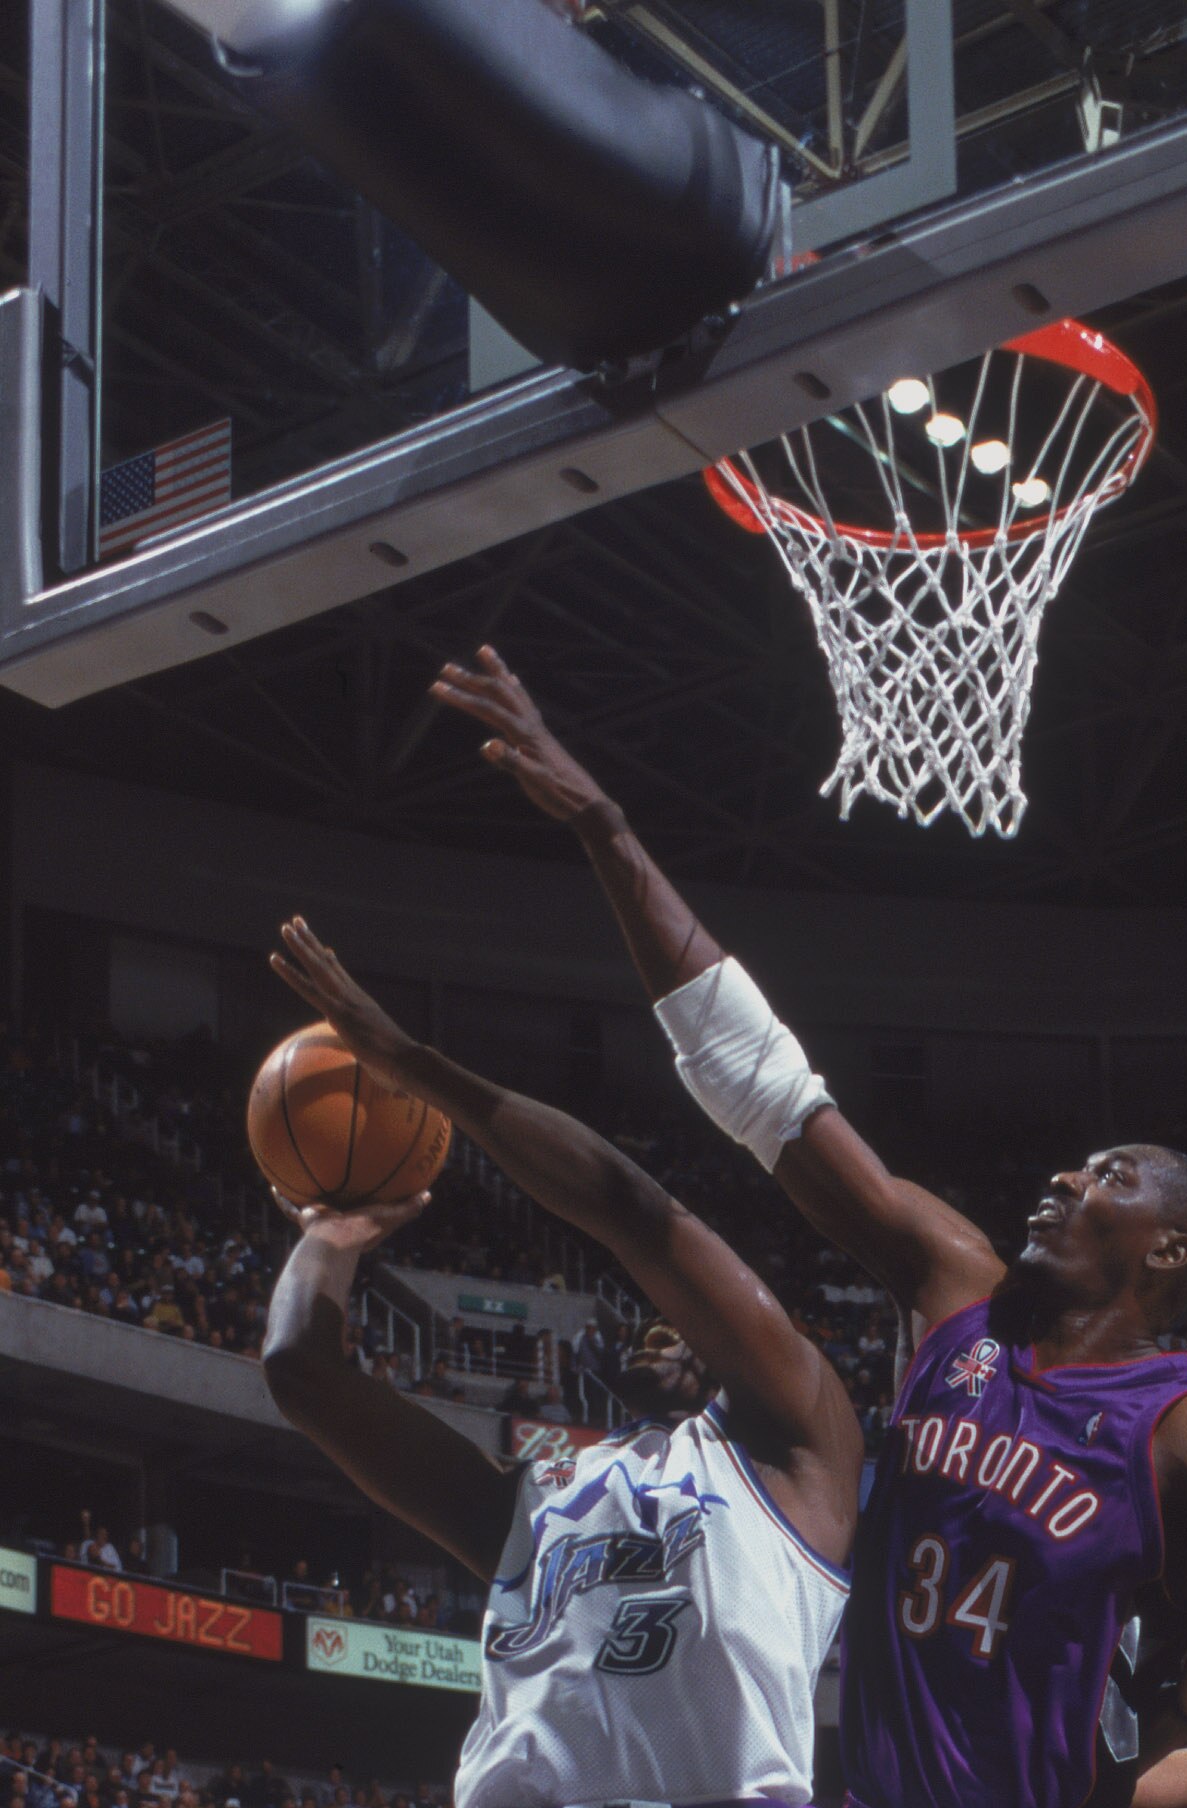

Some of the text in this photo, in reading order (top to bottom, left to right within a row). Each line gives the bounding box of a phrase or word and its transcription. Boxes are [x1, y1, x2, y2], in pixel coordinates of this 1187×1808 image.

[899, 1416, 1103, 1541] TORONTO
[87, 1576, 252, 1651] GO JAZZ
[485, 1507, 706, 1662] JAZZ
[899, 1534, 1015, 1660] 34
[363, 1652, 482, 1687] Dodge Dealers
[383, 1632, 464, 1663] Your Utah
[594, 1597, 691, 1676] 3
